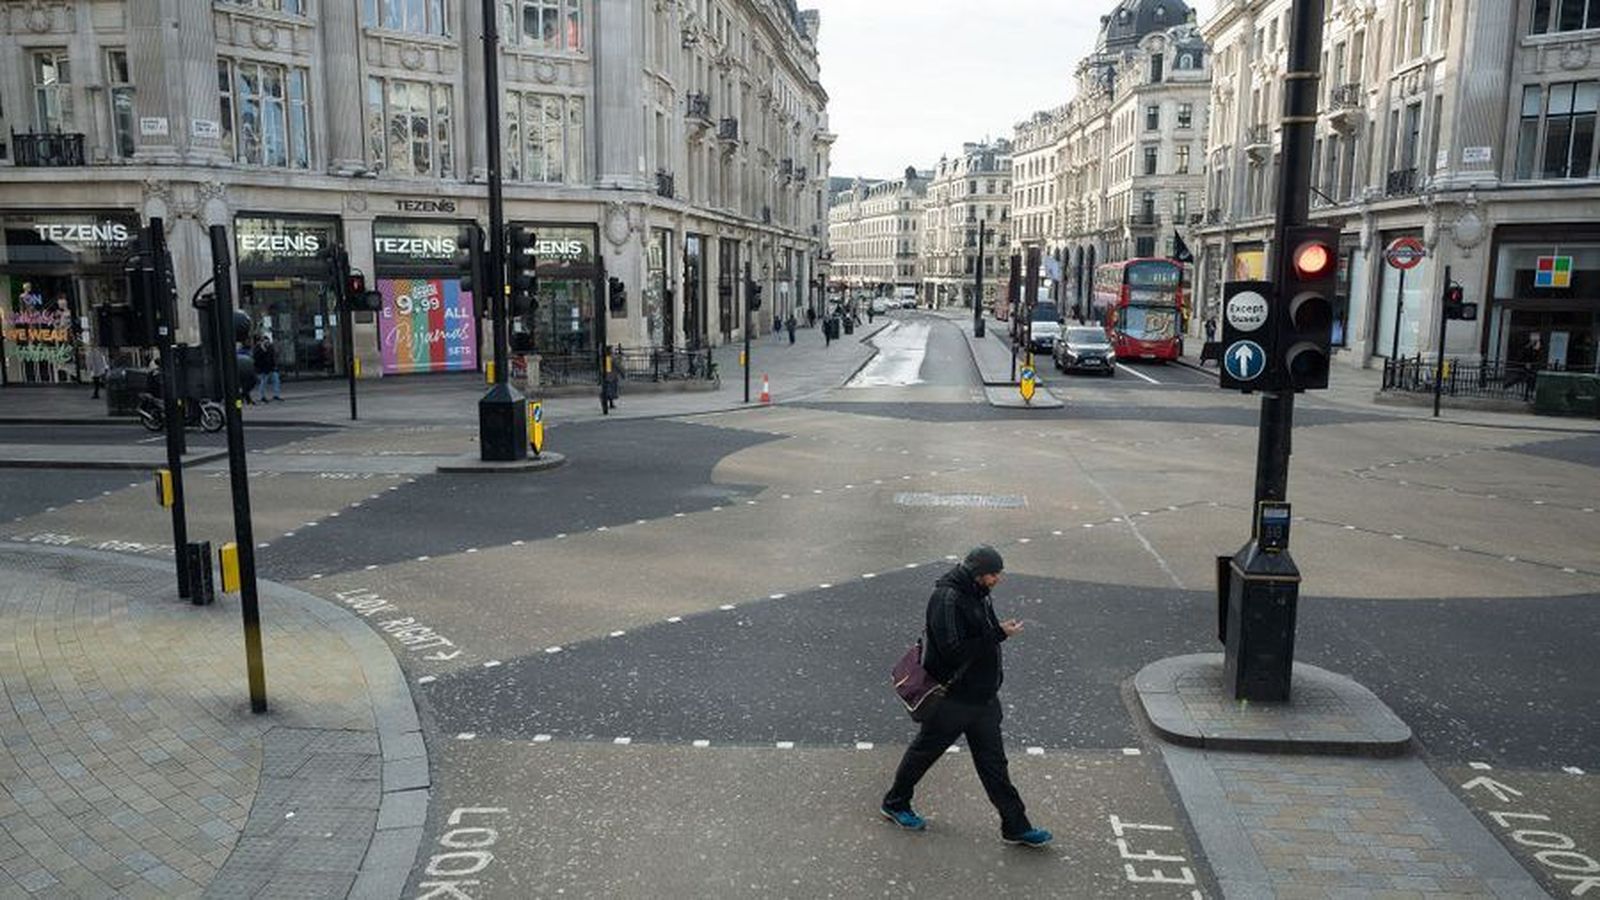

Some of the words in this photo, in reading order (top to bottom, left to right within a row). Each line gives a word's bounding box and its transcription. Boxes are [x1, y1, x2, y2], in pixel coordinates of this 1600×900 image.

[395, 199, 456, 213] TEZENIS
[35, 220, 128, 241] TEZENIS
[237, 232, 319, 251] EZENIS
[444, 307, 469, 318] ALL
[1230, 303, 1264, 314] Except
[336, 588, 398, 617] LOOK
[378, 616, 453, 651] RIGHT
